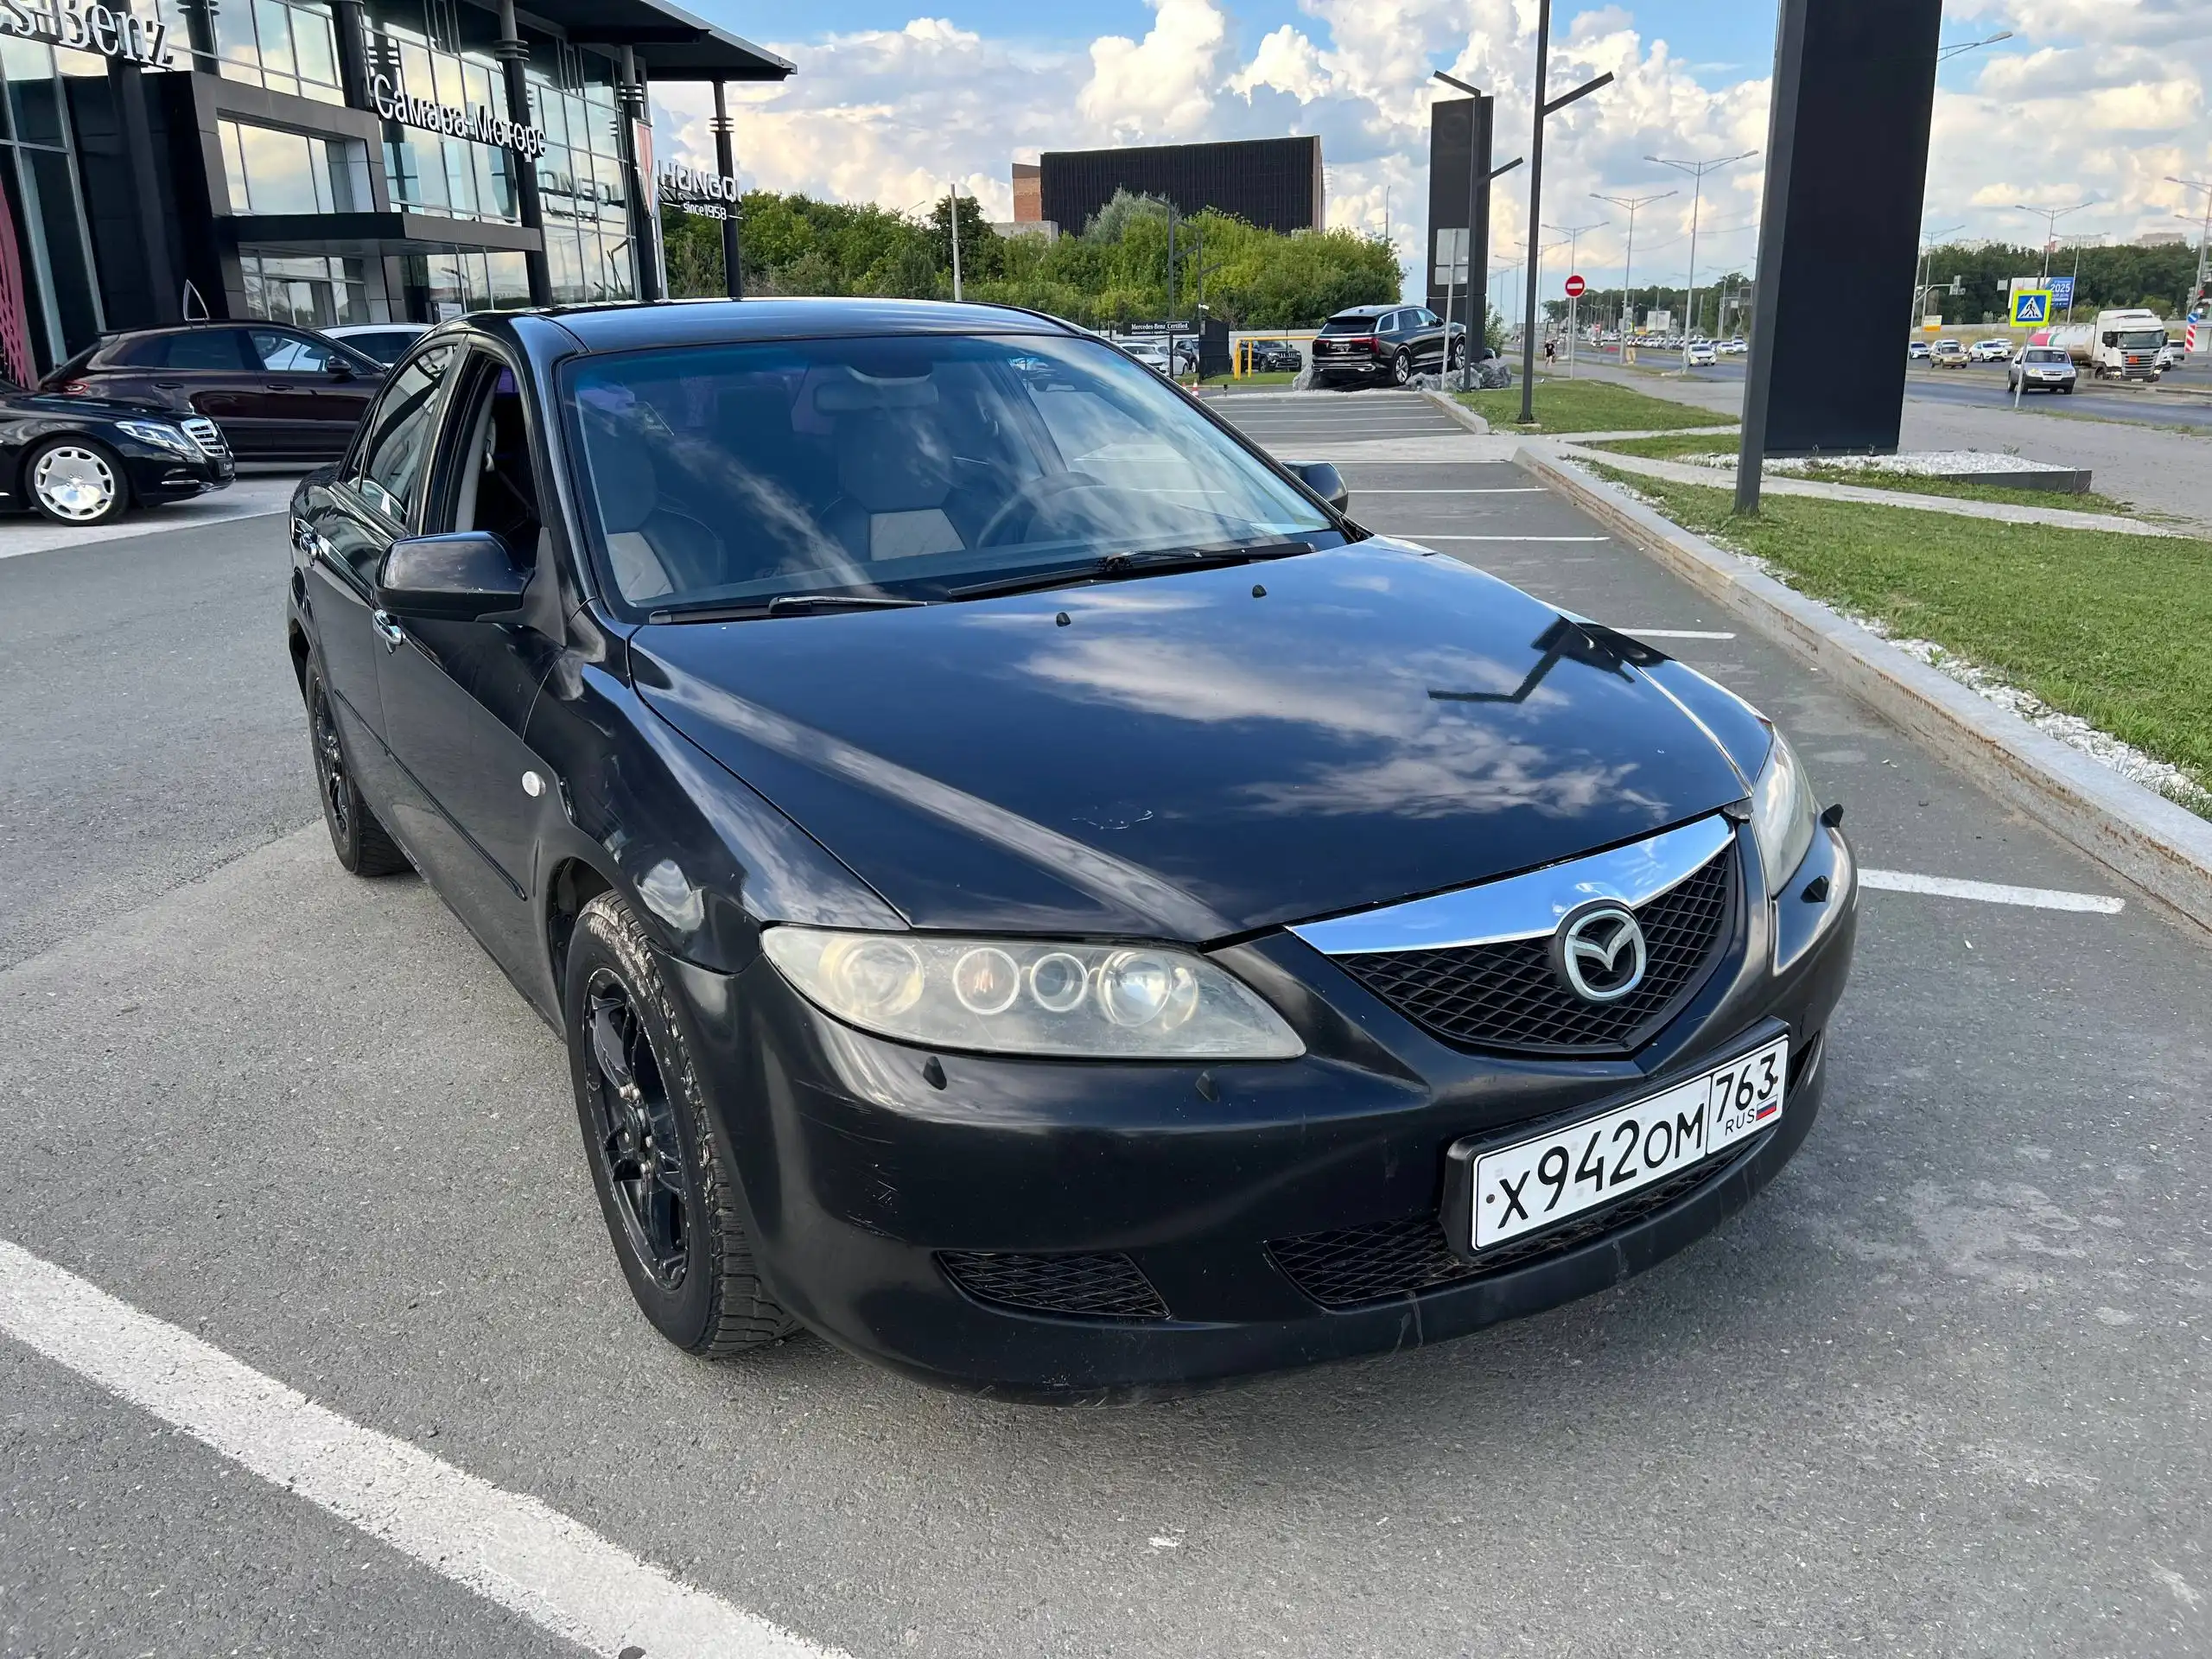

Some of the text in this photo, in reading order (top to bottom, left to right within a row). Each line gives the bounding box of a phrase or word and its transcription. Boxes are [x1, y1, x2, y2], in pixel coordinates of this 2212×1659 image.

[658, 159, 742, 203] HONGQI
[683, 201, 727, 220] since 1958
[1715, 1052, 1777, 1123] 763
[1725, 1108, 1756, 1135] RUS
